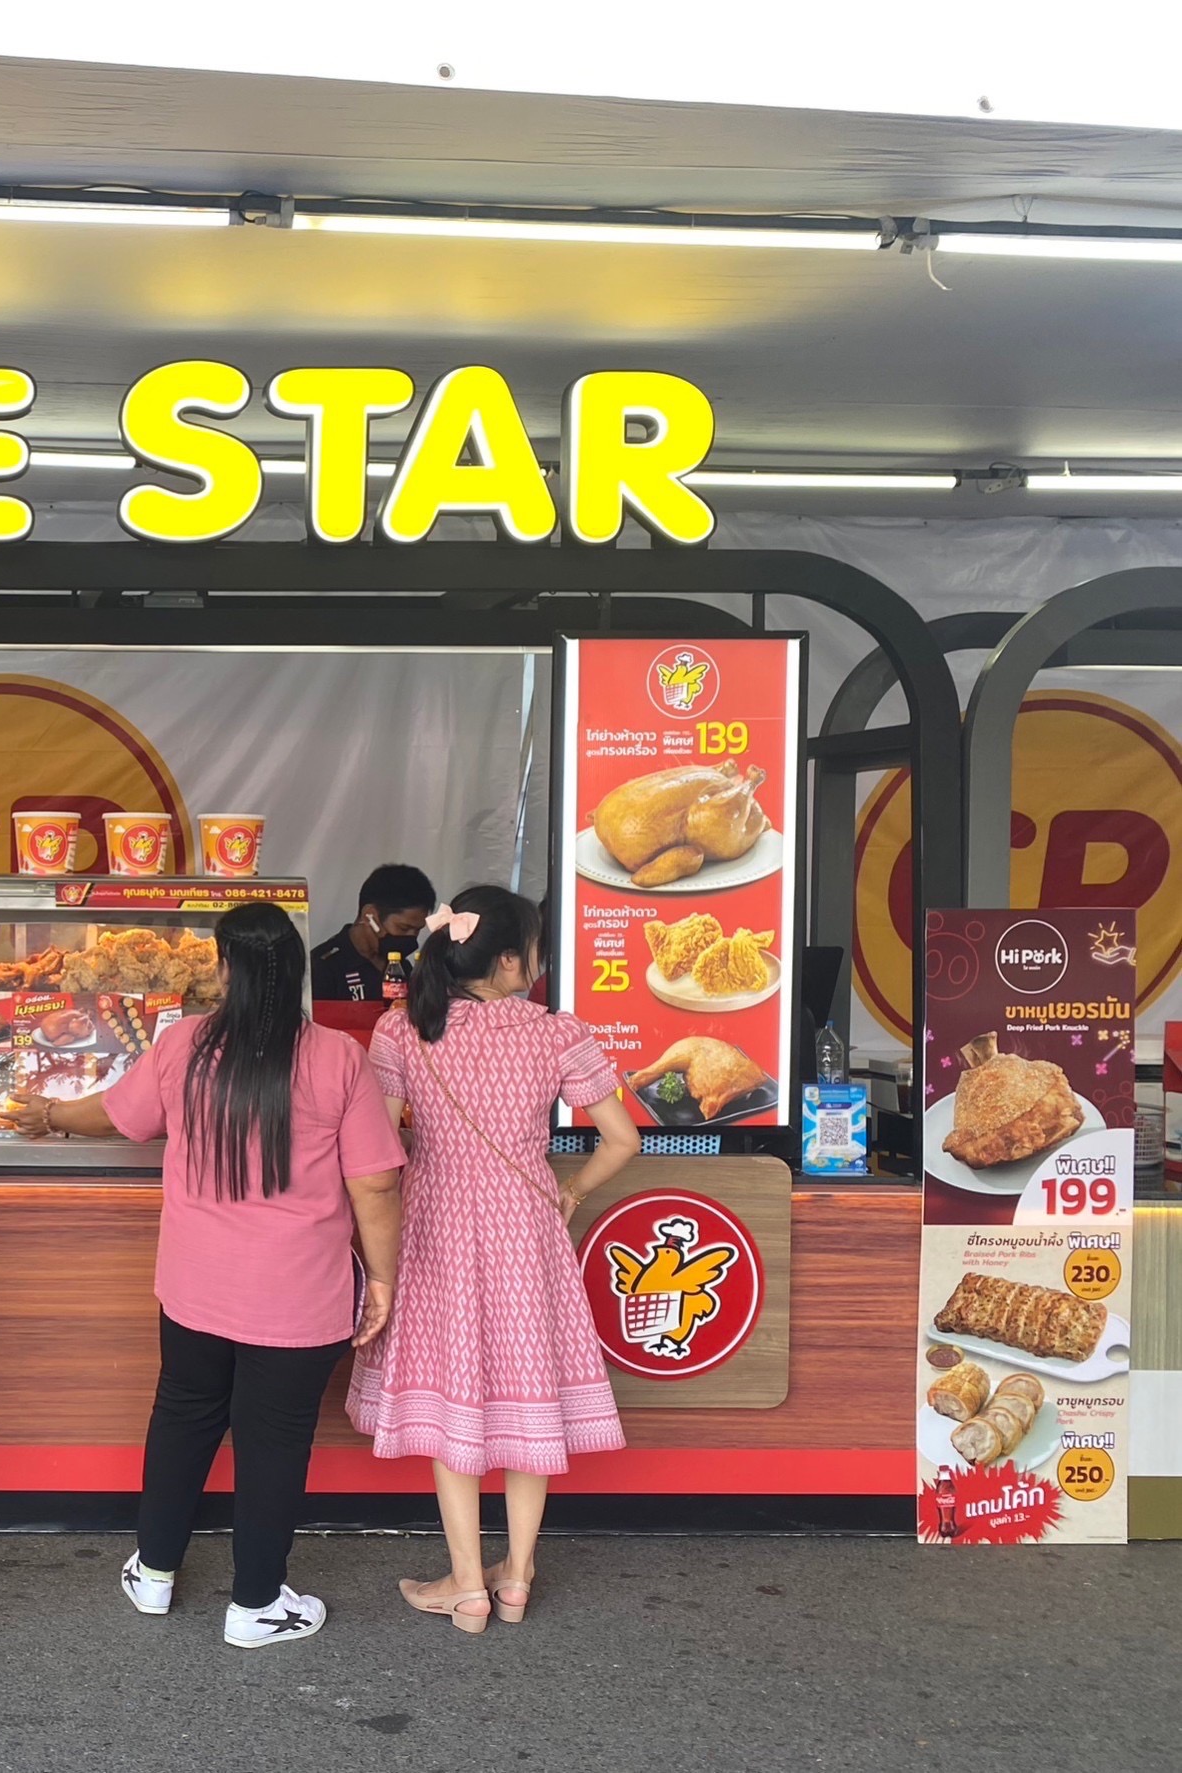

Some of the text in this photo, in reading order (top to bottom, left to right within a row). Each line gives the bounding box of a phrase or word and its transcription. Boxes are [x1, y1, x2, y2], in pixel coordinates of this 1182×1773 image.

[118, 359, 716, 544] STAR
[225, 889, 305, 898] 086-421-8478
[1001, 948, 1019, 964] Hi
[1005, 995, 1130, 1024] ขาหมูเยอรมัน
[1007, 1024, 1025, 1032] Deep
[1055, 1154, 1116, 1175] พิเศษ!!
[1067, 1231, 1121, 1250] พิเศษ!!
[963, 1250, 996, 1258] Braised
[998, 1250, 1017, 1258] Pork
[982, 1259, 1009, 1267] Honey
[1090, 1410, 1115, 1418] Crispy
[1061, 1431, 1115, 1449] พิเศษ!!
[965, 1481, 1045, 1518] แถมโค้ก
